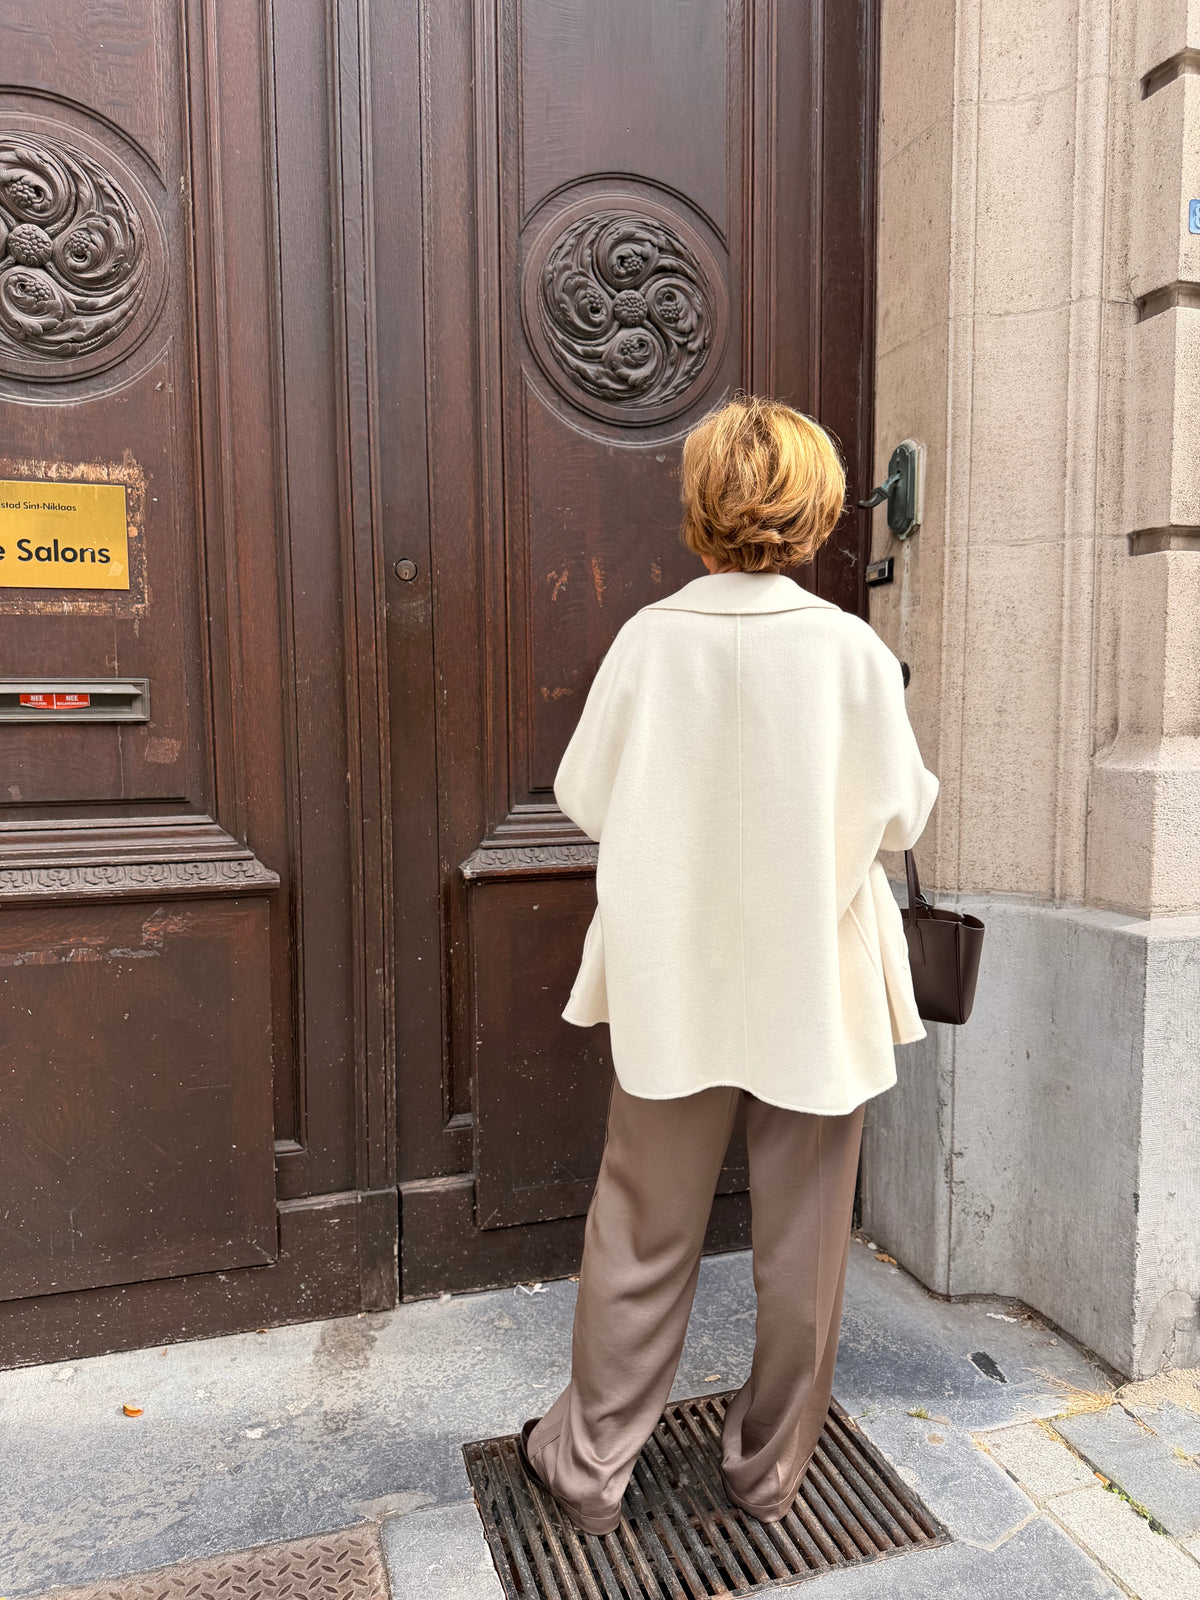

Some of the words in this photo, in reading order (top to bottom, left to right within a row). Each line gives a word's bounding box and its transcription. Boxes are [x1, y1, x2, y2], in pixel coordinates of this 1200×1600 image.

[0, 500, 21, 509] stad
[23, 501, 77, 512] Sint-Niklaas
[17, 539, 111, 564] Salons
